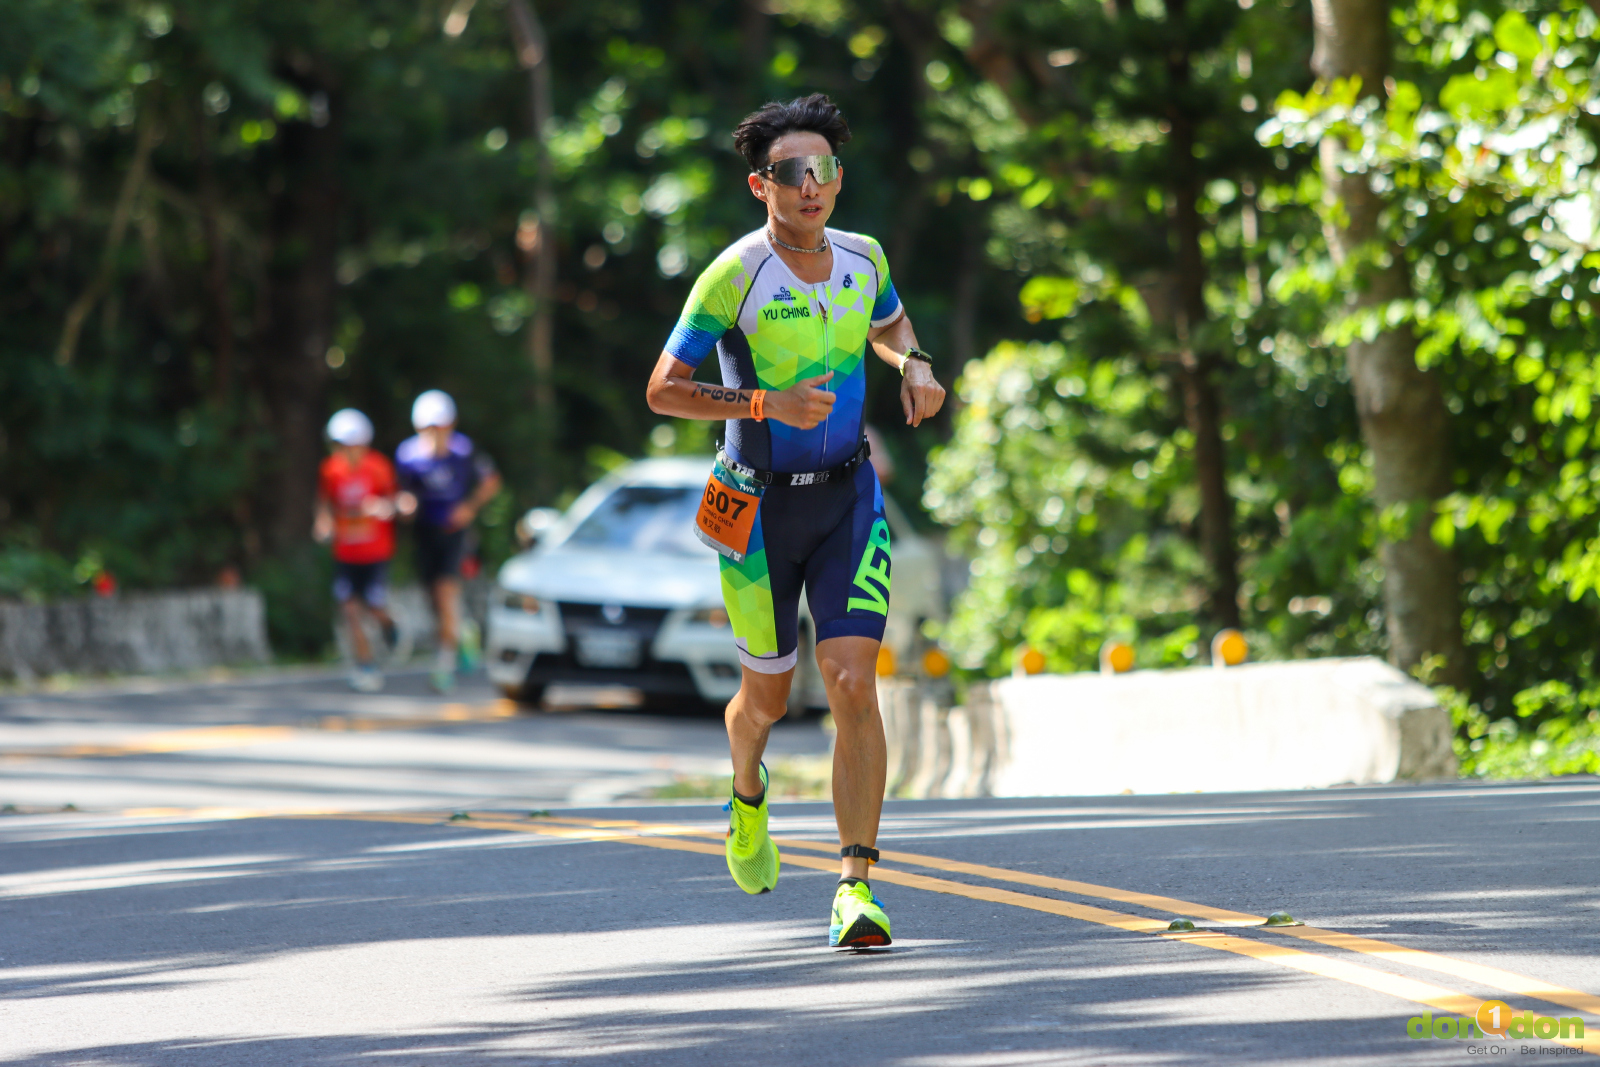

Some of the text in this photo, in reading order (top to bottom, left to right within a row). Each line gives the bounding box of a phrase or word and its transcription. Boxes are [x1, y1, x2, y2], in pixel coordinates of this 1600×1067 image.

[763, 307, 810, 320] YU CHING
[739, 483, 756, 494] TWN
[704, 483, 749, 521] 607
